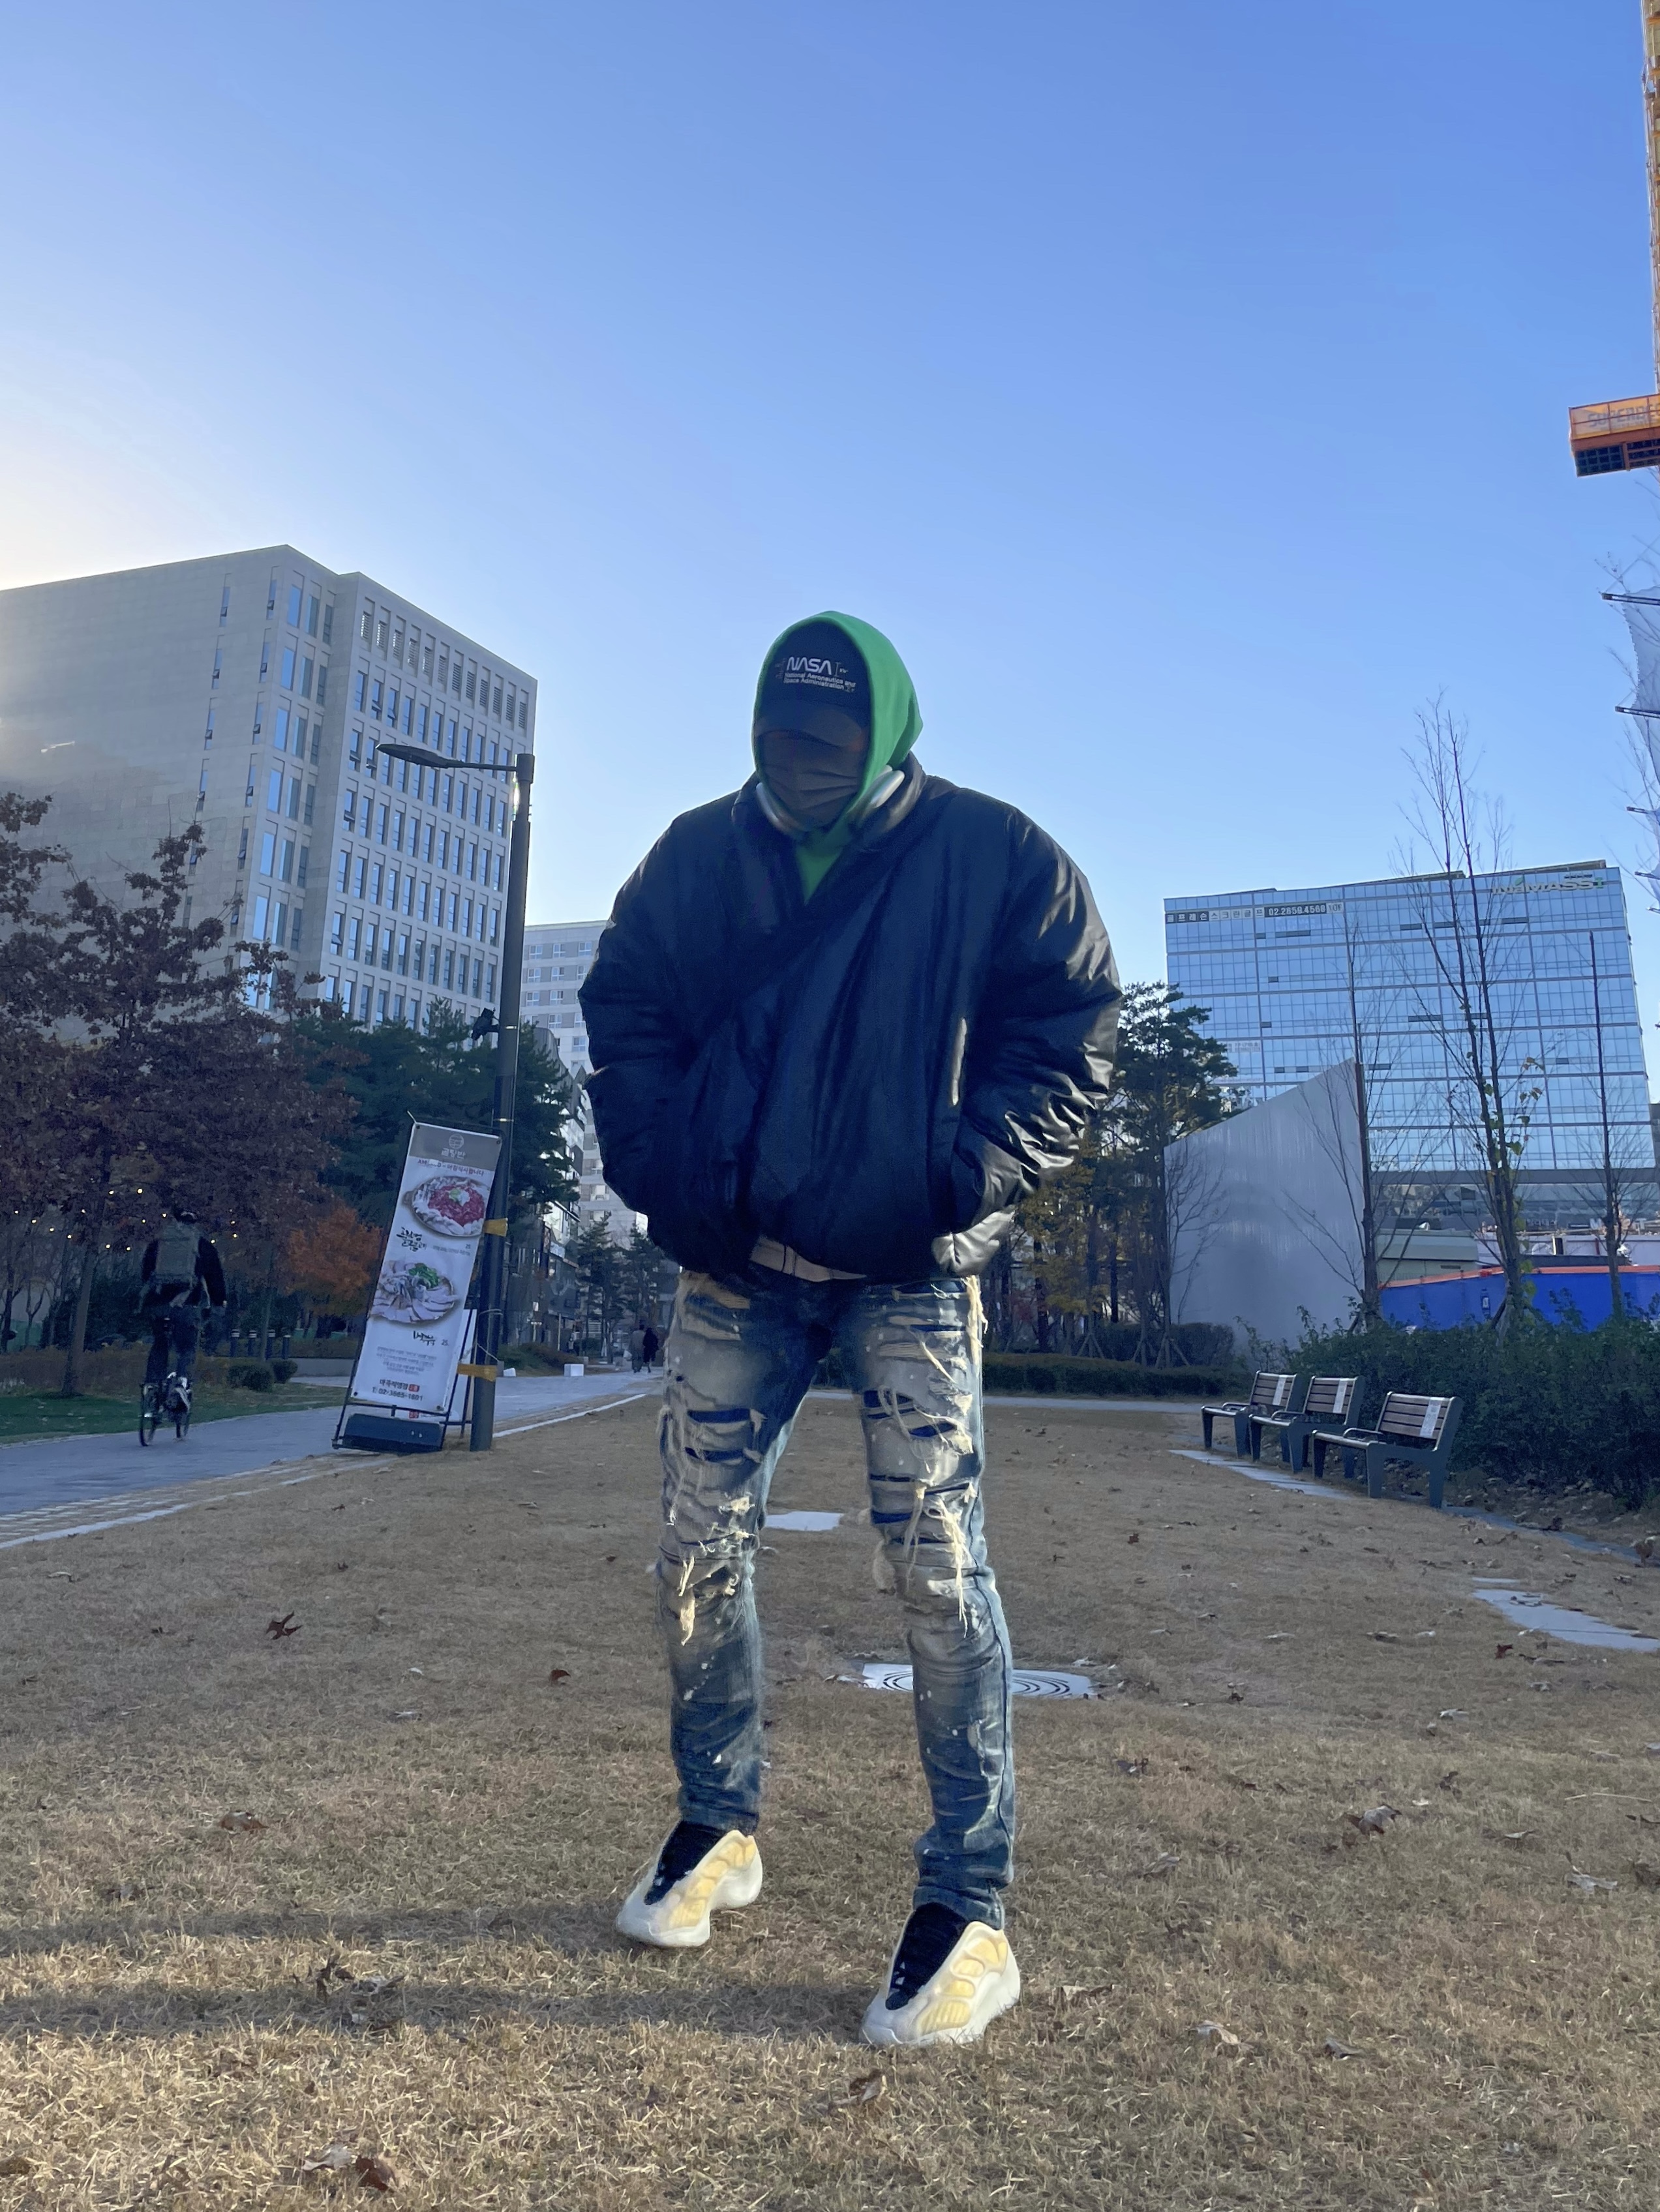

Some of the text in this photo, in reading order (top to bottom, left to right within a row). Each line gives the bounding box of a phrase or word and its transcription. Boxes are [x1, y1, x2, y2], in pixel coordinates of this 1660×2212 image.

[786, 657, 832, 675] NASA
[800, 678, 844, 690] Administration
[807, 673, 843, 684] Aeronautics
